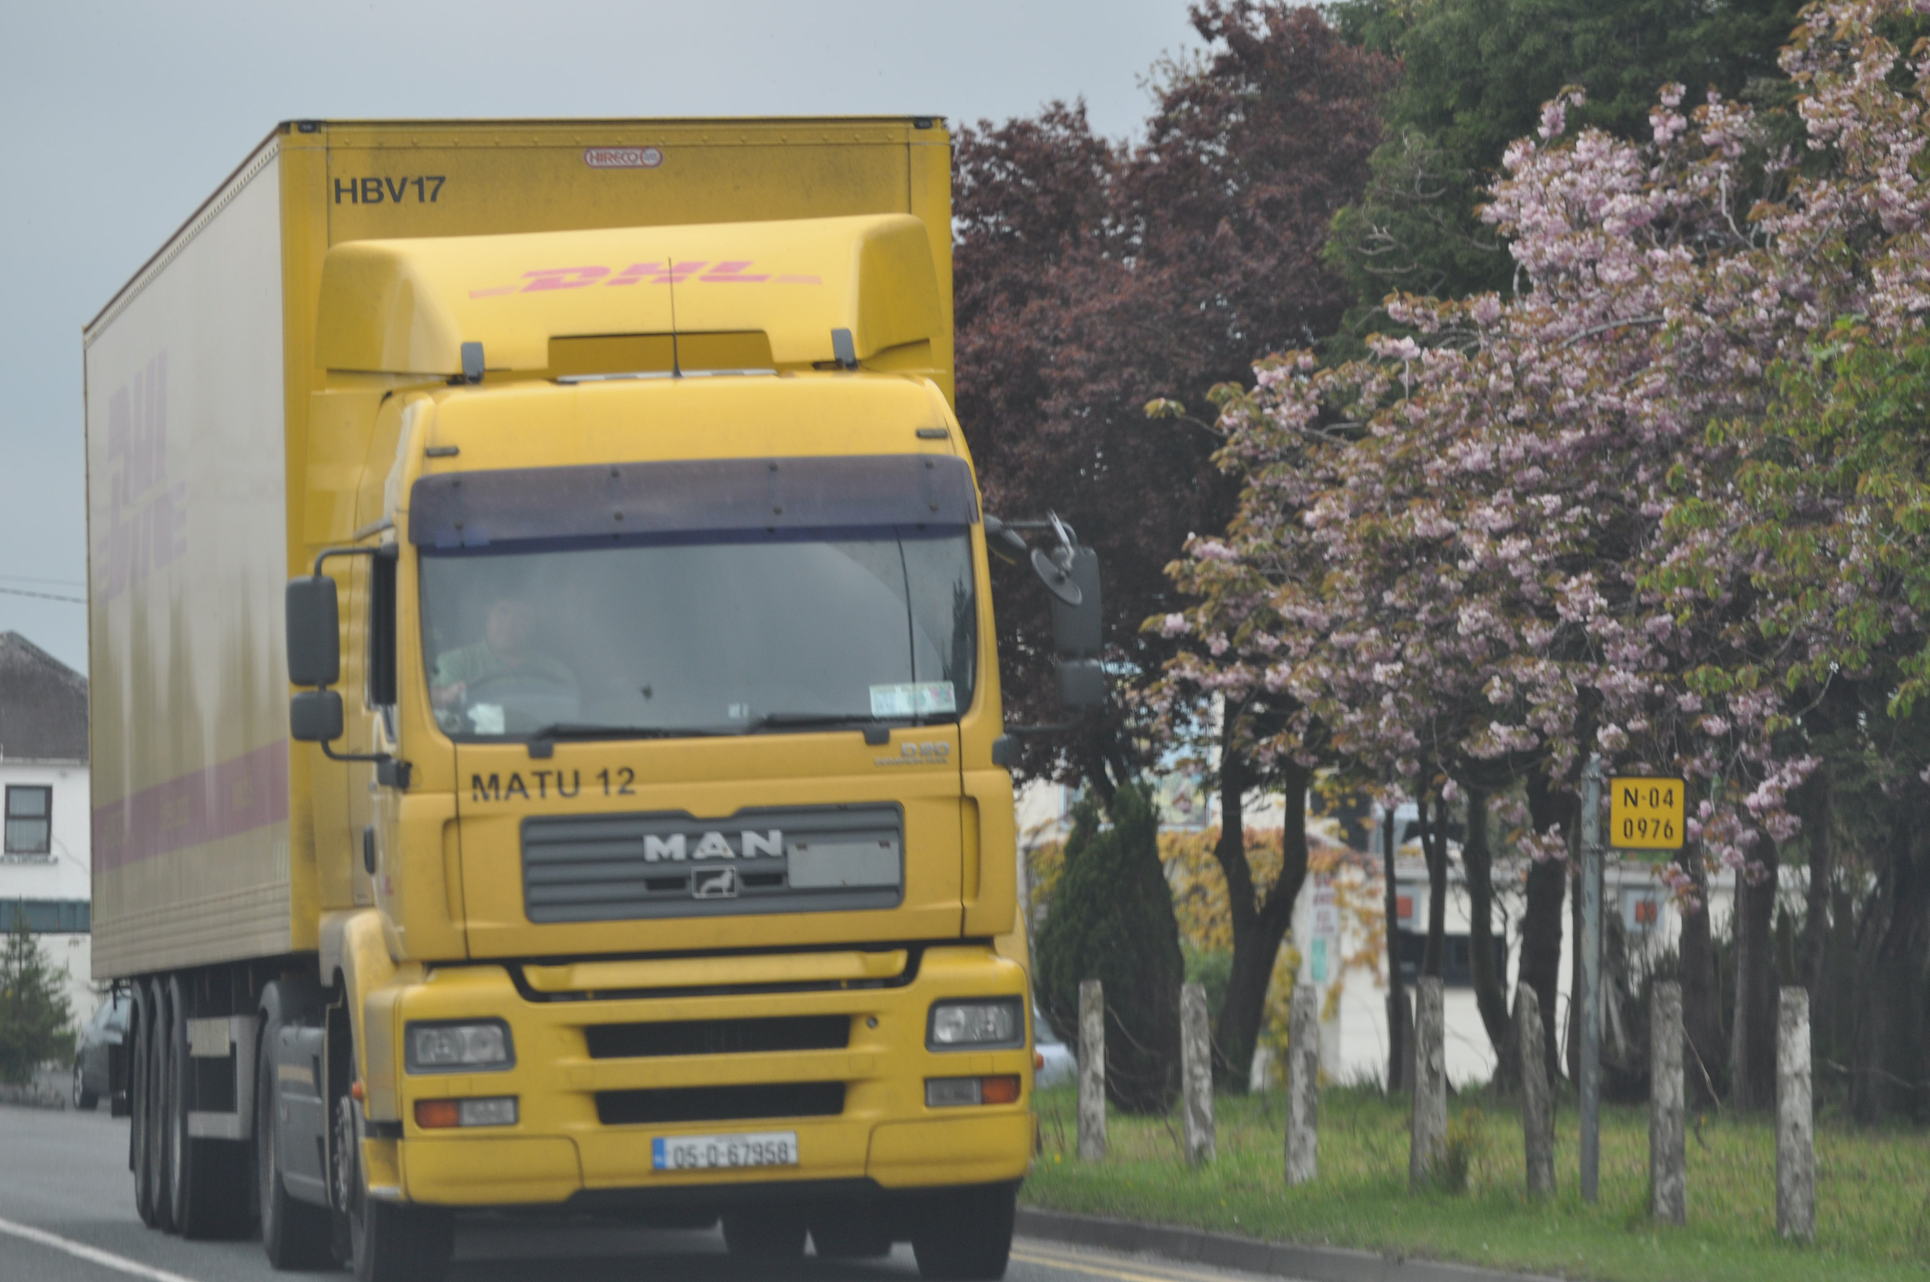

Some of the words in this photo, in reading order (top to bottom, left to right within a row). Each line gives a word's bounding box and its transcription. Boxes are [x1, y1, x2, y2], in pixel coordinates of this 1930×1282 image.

[334, 175, 446, 204] HBV17
[519, 260, 772, 293] DHL
[471, 769, 580, 802] MATU
[596, 767, 636, 796] 12
[1623, 818, 1674, 840] 0976
[644, 829, 783, 863] MAN
